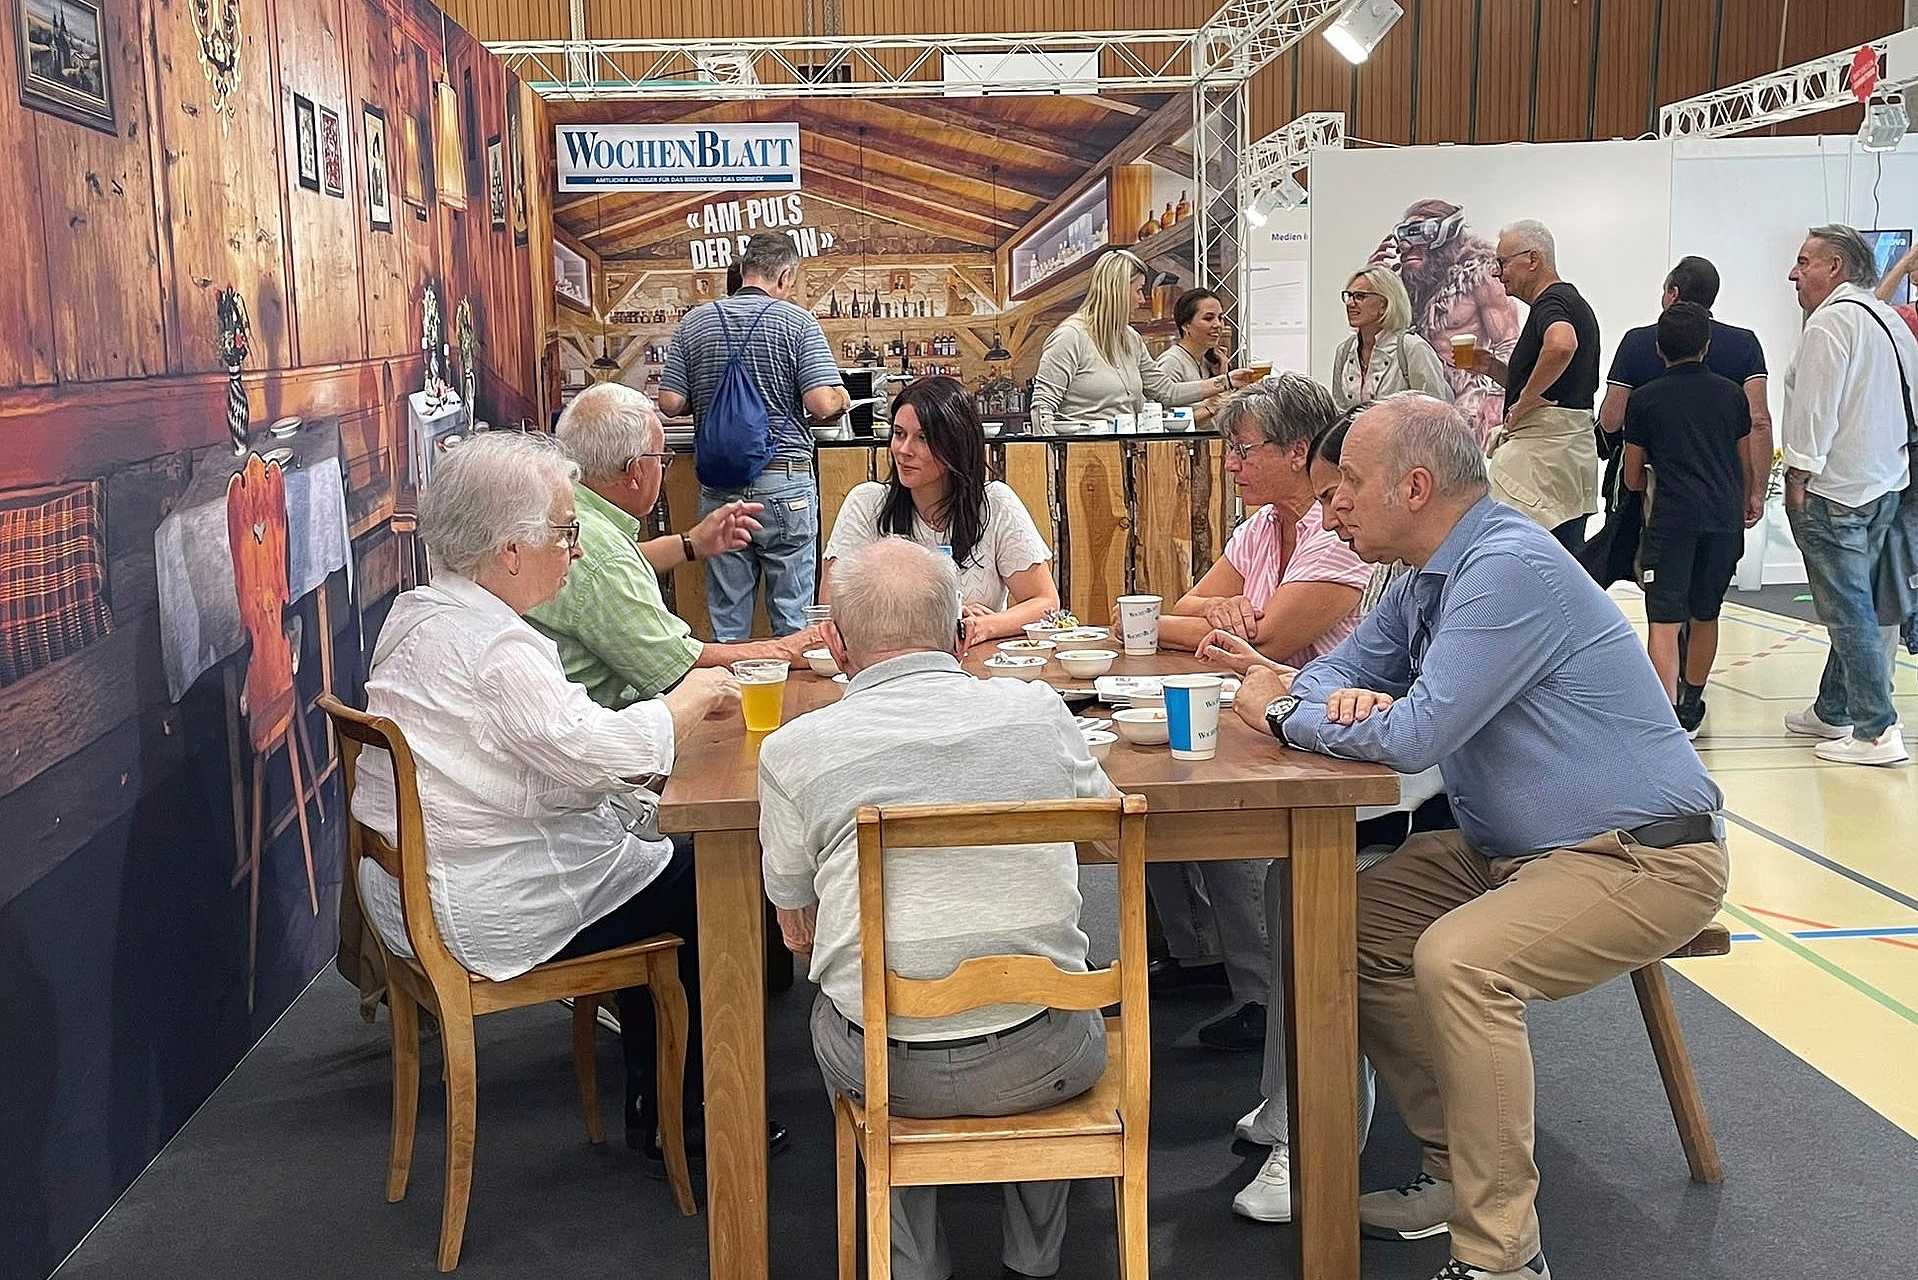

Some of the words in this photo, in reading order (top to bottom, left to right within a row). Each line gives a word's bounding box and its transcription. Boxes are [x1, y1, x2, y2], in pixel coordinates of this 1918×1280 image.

[746, 194, 803, 229] PULS
[1271, 232, 1302, 241] Medien
[689, 237, 733, 270] DER
